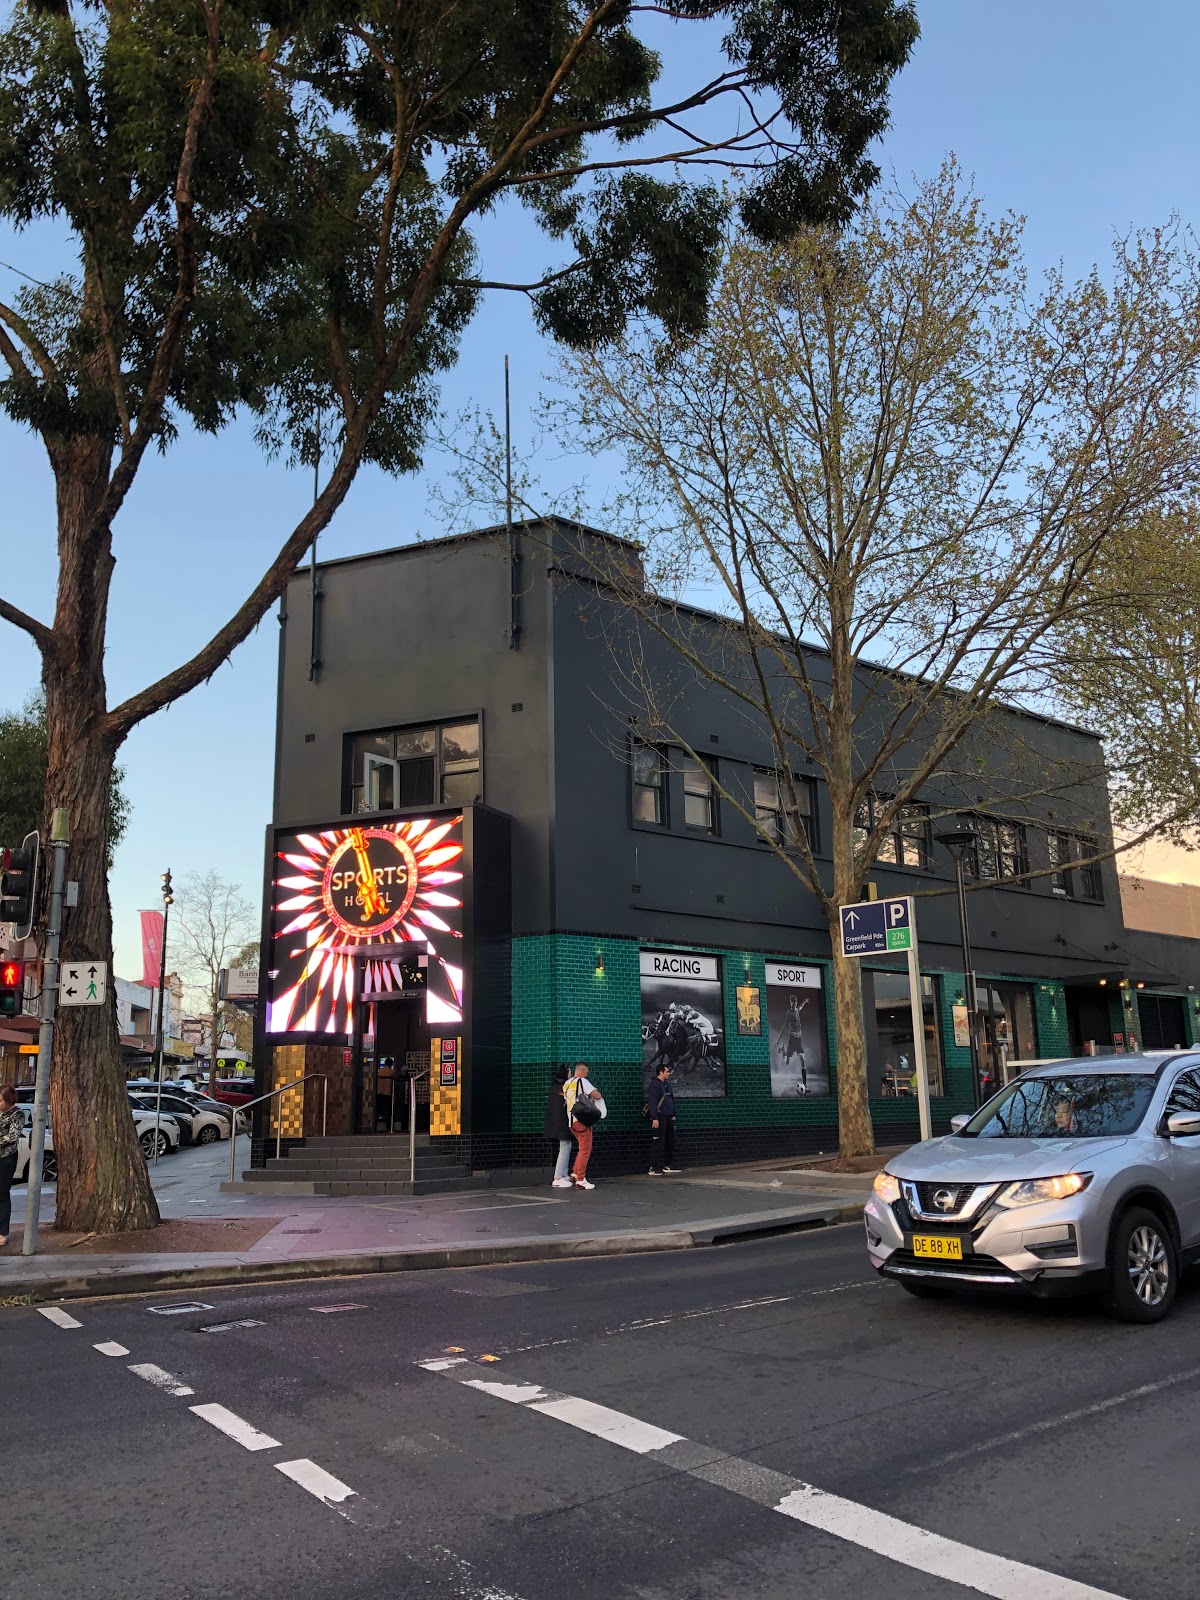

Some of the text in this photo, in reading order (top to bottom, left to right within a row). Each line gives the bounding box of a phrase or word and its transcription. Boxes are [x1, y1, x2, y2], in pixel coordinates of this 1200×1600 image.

[345, 892, 392, 907] HOL
[890, 904, 904, 926] P
[845, 931, 883, 943] Greenfield Pde
[892, 932, 905, 940] 276
[846, 943, 866, 951] Carpark
[654, 957, 701, 974] RACING
[777, 969, 806, 983] SPORT
[915, 1239, 960, 1254] DE 88 XH
